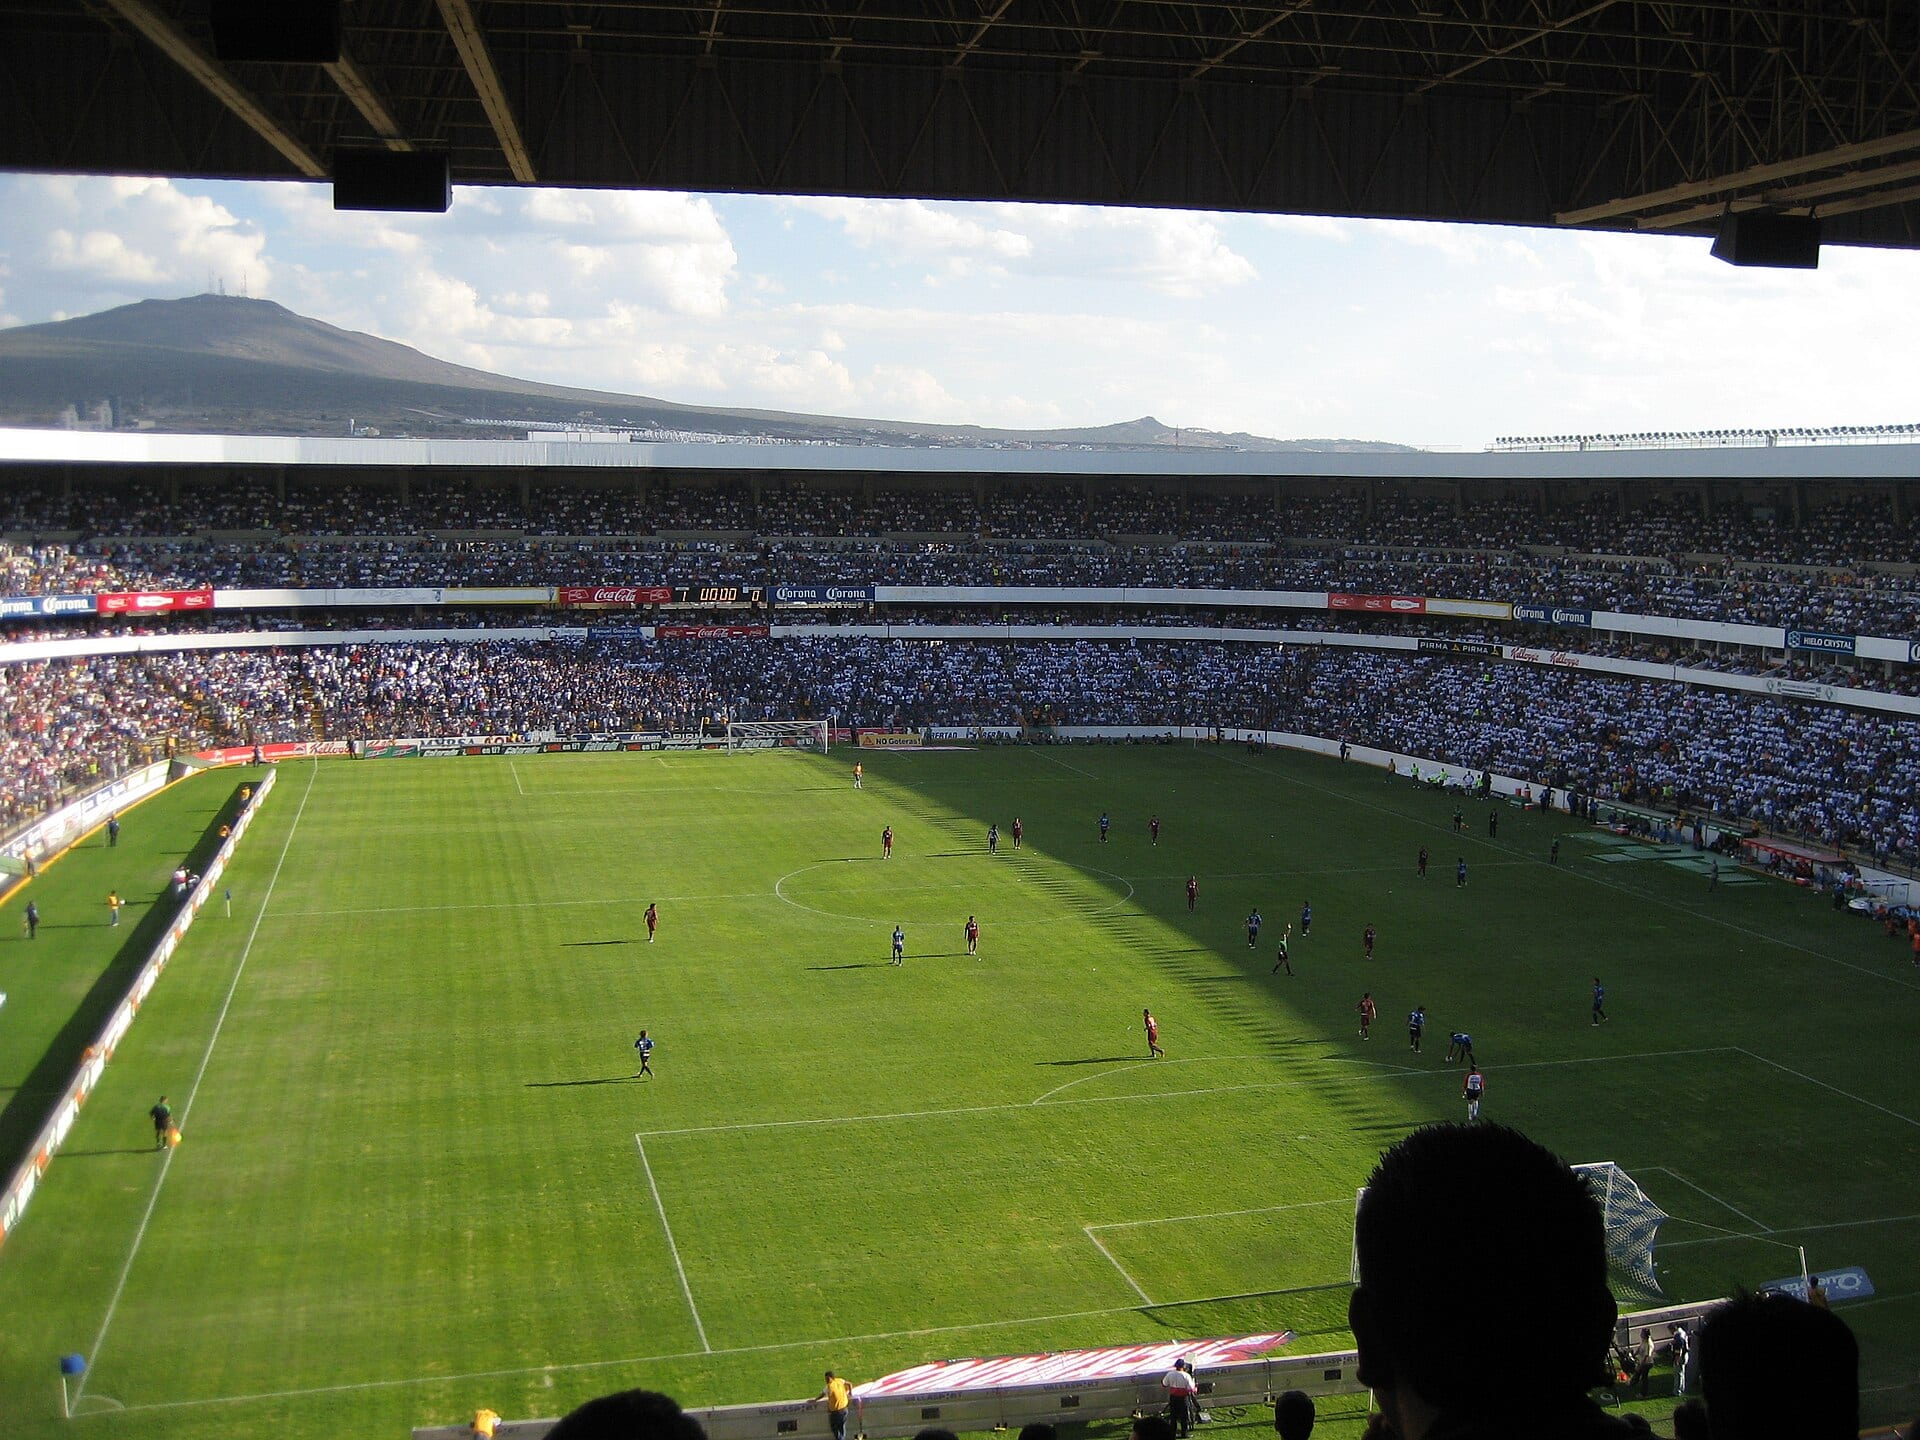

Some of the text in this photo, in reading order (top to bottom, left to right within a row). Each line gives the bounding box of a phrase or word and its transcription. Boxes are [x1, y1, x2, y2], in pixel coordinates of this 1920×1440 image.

[594, 588, 636, 602] Coca-Cola
[776, 587, 866, 600] Corona Corona
[0, 600, 33, 616] orona
[43, 597, 89, 614] Corona
[1513, 605, 1585, 624] Corona Corona
[1420, 641, 1488, 653] PIRMA PIRMA
[1803, 637, 1853, 649] HIELO CRYSTAL
[888, 737, 921, 745] Goteras!
